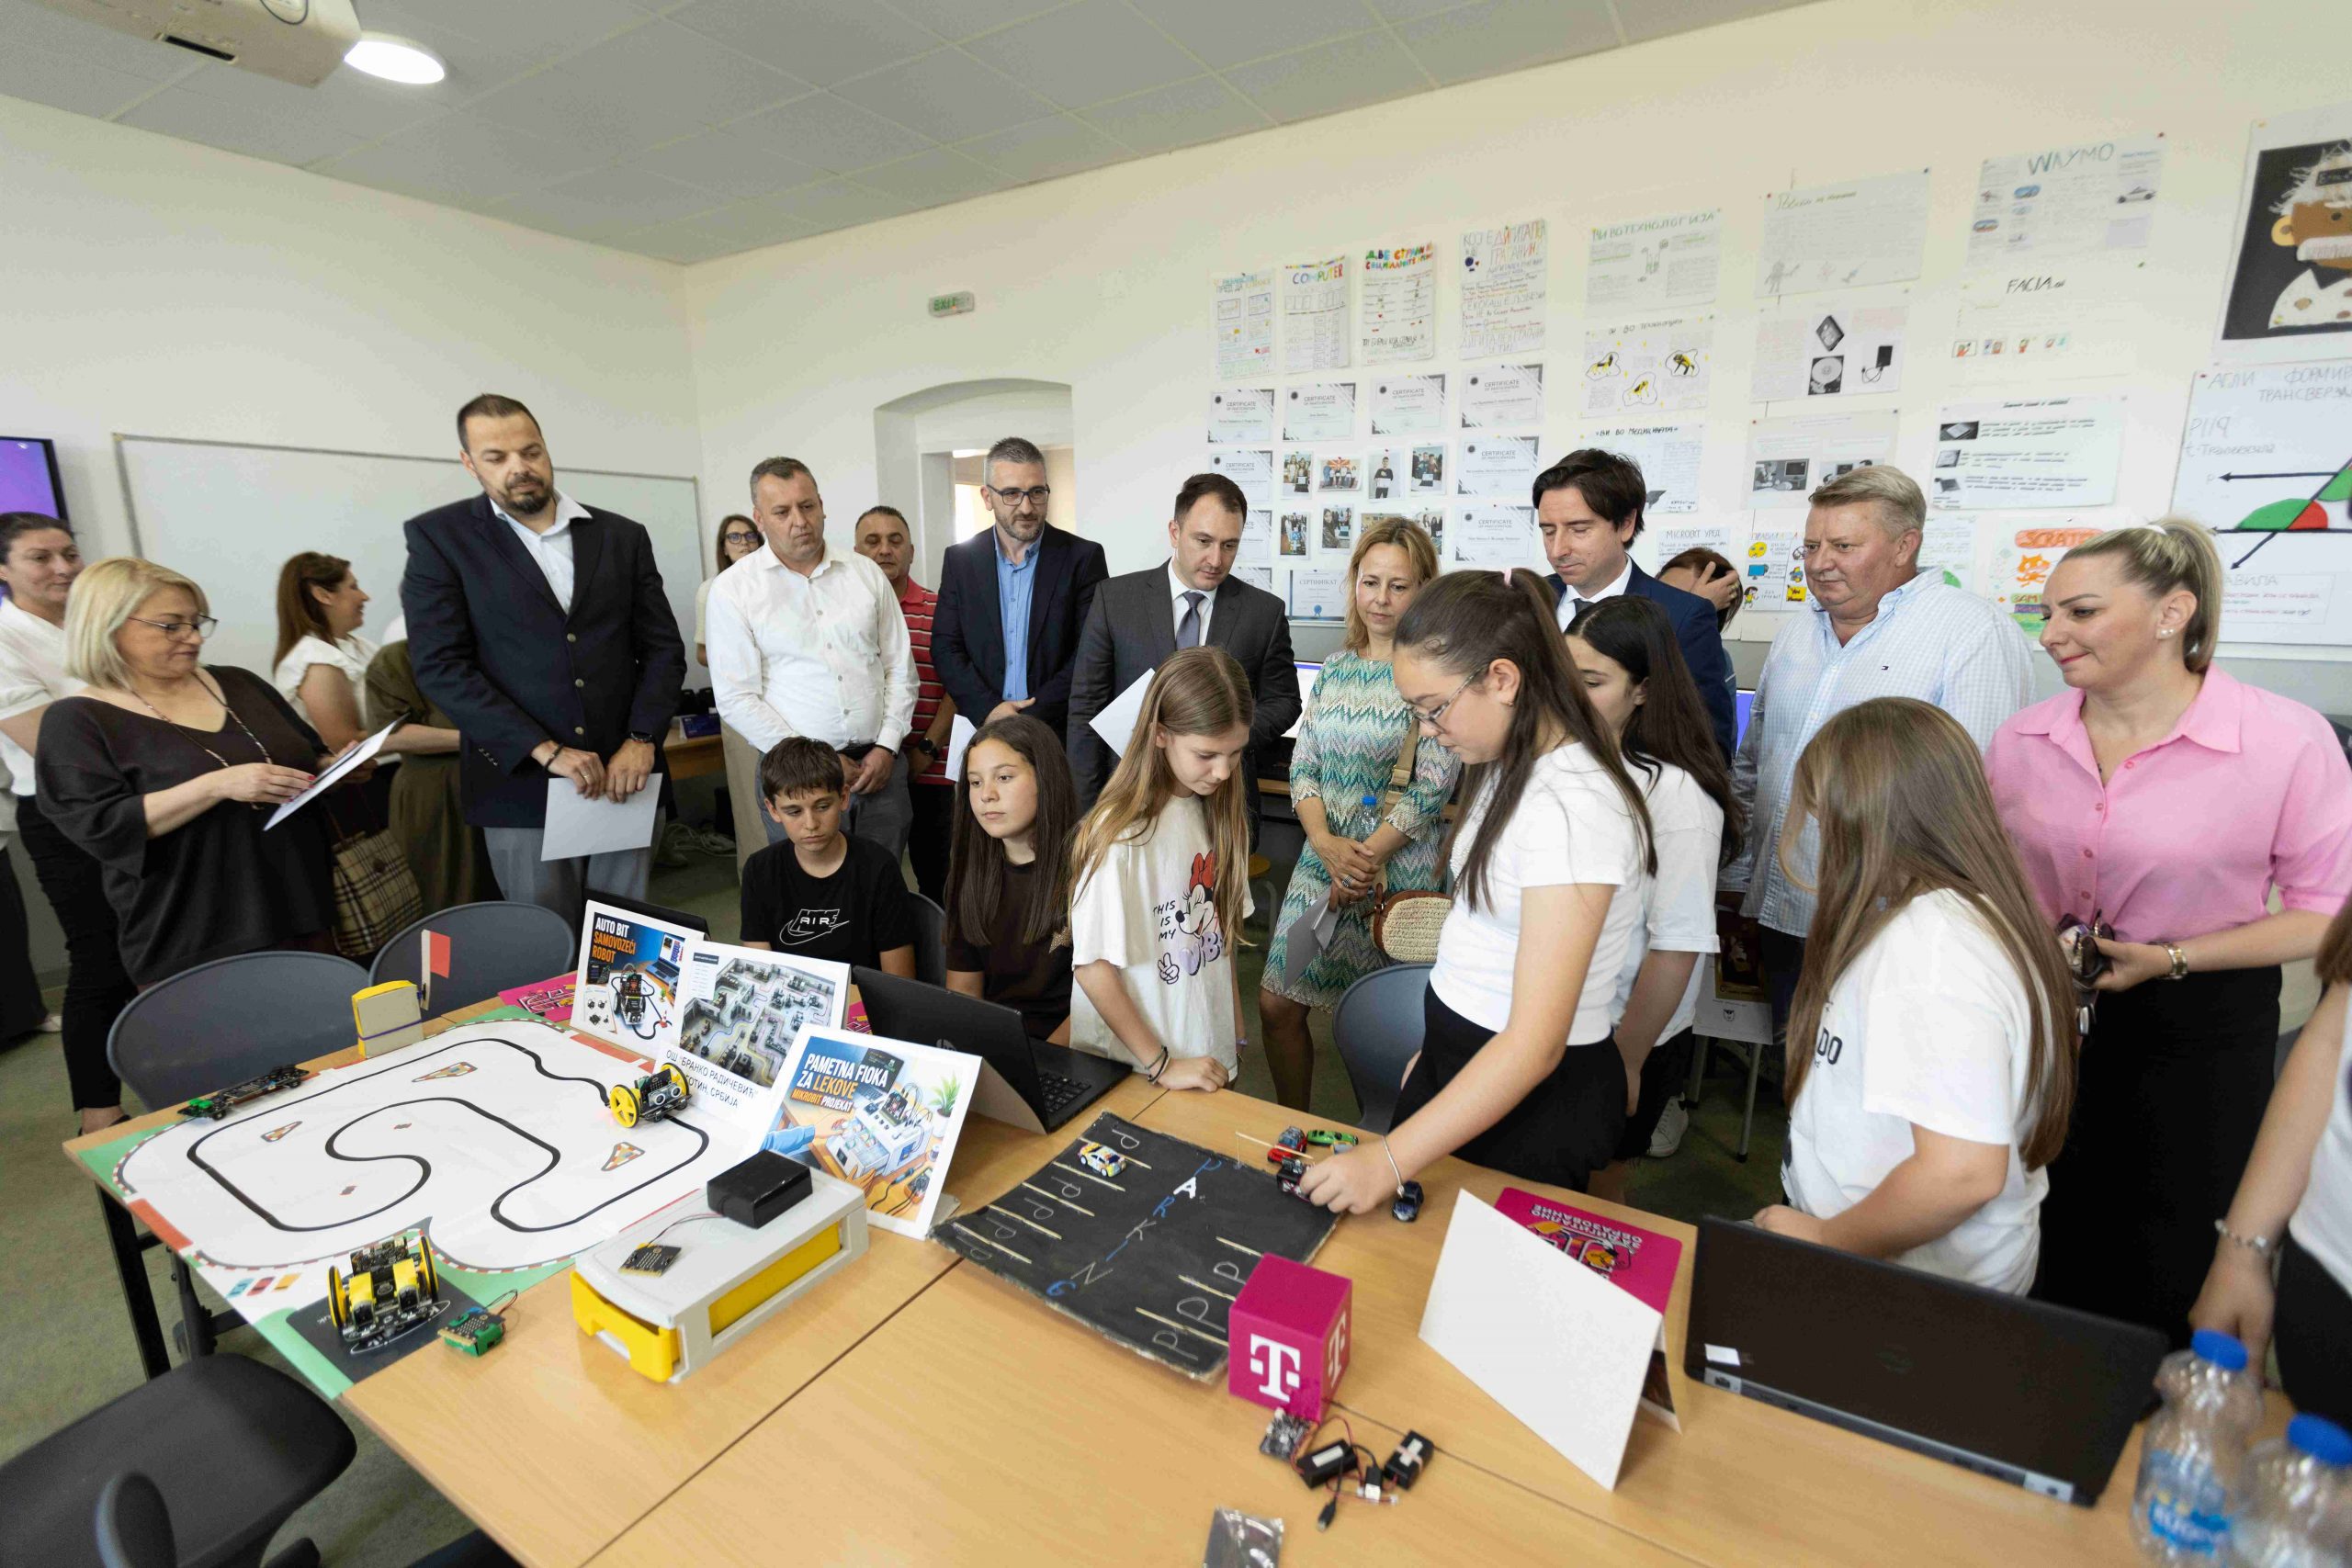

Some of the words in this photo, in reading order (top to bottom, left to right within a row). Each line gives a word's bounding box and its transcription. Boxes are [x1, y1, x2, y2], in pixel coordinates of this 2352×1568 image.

[2028, 142, 2115, 175] WAYMO
[1292, 263, 1343, 285] COMPUTER
[1484, 379, 1520, 388] CERTIFICATE
[2224, 573, 2278, 587] АВИЛА
[1153, 900, 1176, 917] THIS
[595, 917, 616, 934] AUTO
[616, 922, 630, 938] BIT
[799, 917, 830, 925] AIR
[1160, 916, 1171, 927] IS
[594, 931, 637, 955] SAMOVOZEĆI
[1158, 928, 1177, 942] MY
[592, 945, 616, 964] ROBOT
[1180, 931, 1223, 976] VIB
[666, 1050, 678, 1062] ОШ
[804, 1053, 855, 1079] PAMETNA
[854, 1064, 889, 1088] FIOKA
[686, 1075, 708, 1096] ОТИН,
[710, 1088, 738, 1108] СРБИЈА
[797, 1070, 814, 1089] ZA
[812, 1074, 859, 1100] LEKOVE
[791, 1089, 822, 1103] MIKROBIT
[820, 1096, 854, 1112] PROJEKAT
[1250, 1334, 1301, 1404] T
